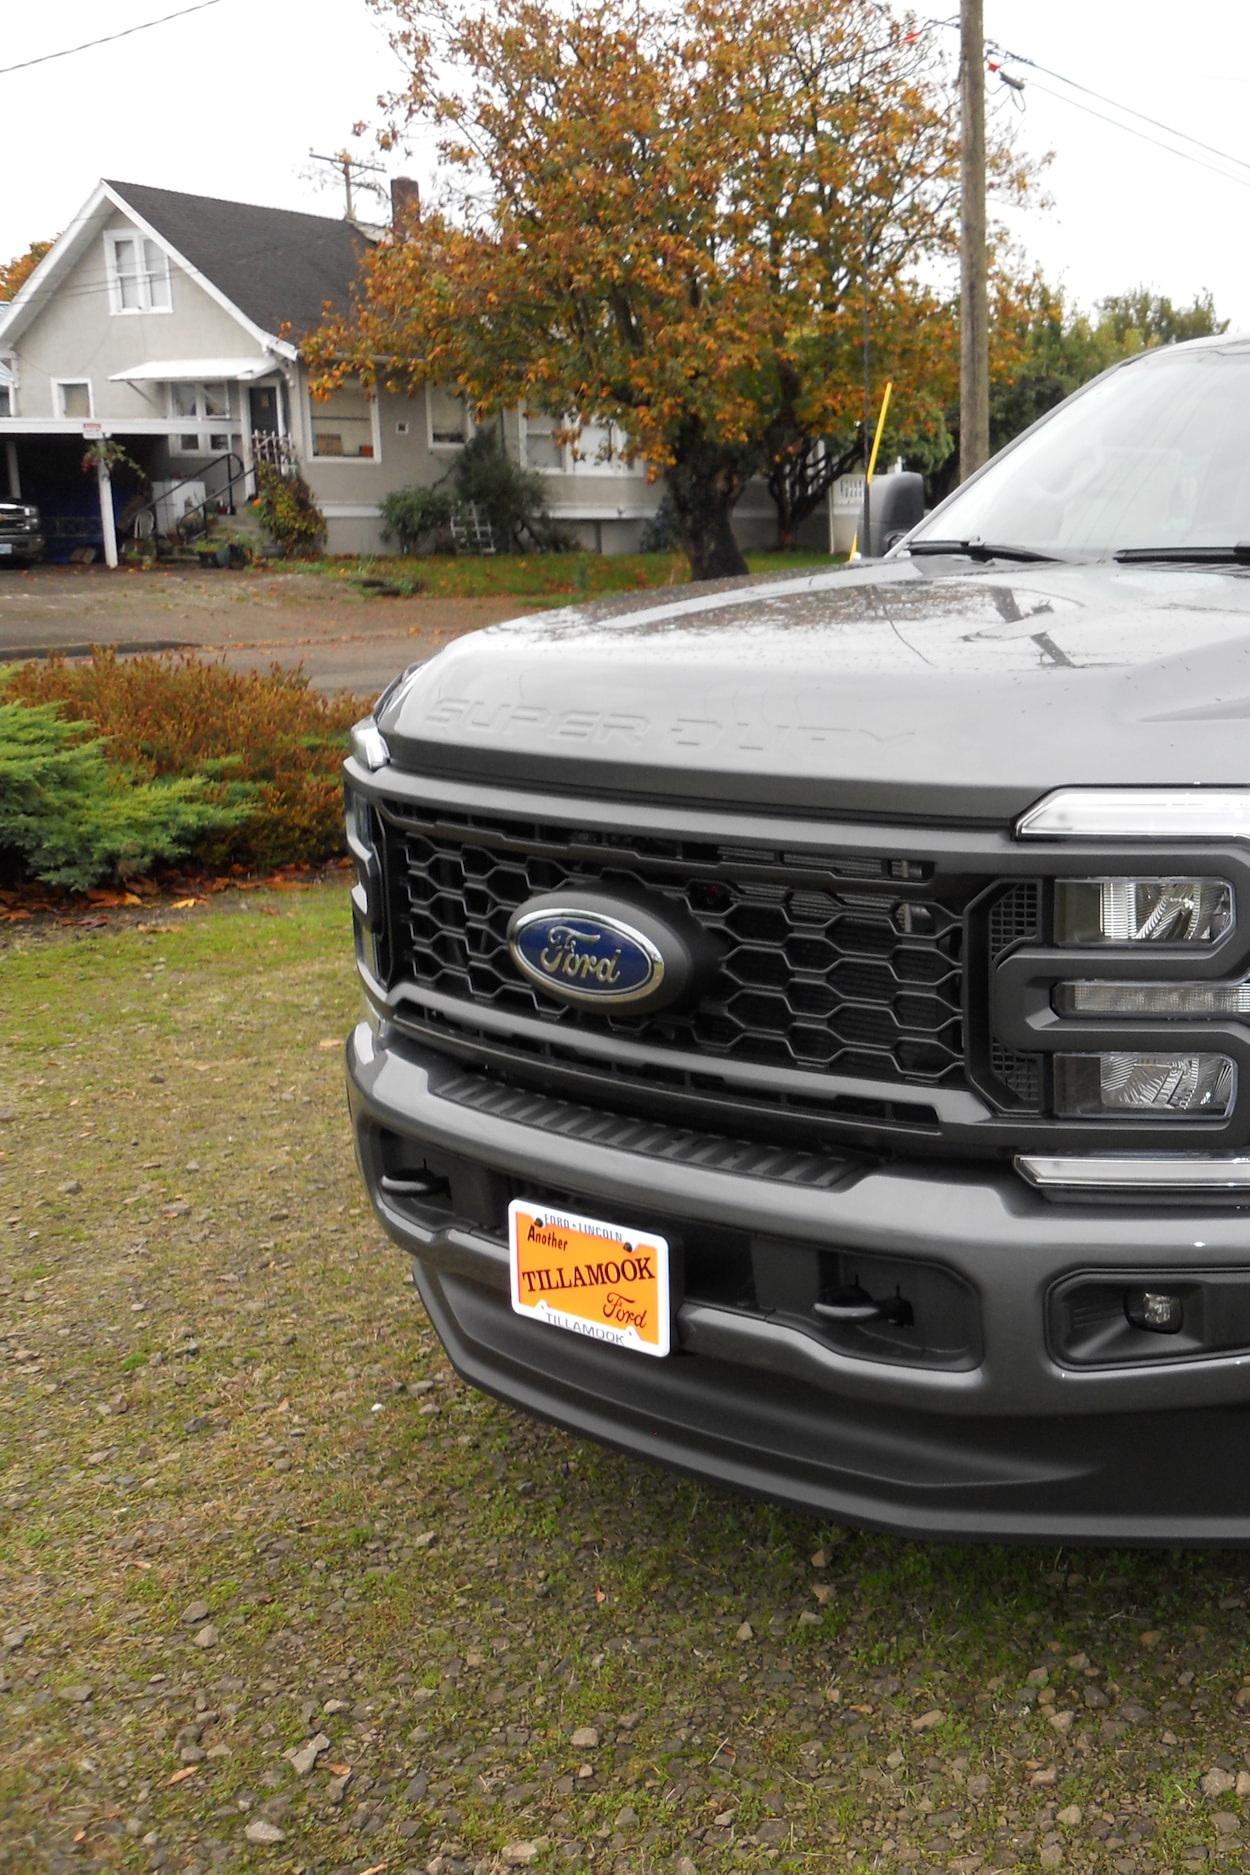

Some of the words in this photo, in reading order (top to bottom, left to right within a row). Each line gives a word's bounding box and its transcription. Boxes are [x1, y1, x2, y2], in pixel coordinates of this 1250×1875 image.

[425, 696, 653, 746] SUPER
[540, 926, 622, 983] Ford
[527, 1225, 568, 1251] Another
[544, 1213, 570, 1229] FORD
[578, 1222, 623, 1242] LINCOLN
[522, 1257, 656, 1292] TILLAMOOK
[602, 1292, 647, 1329] Ford
[545, 1312, 625, 1346] TILLAMOOK
